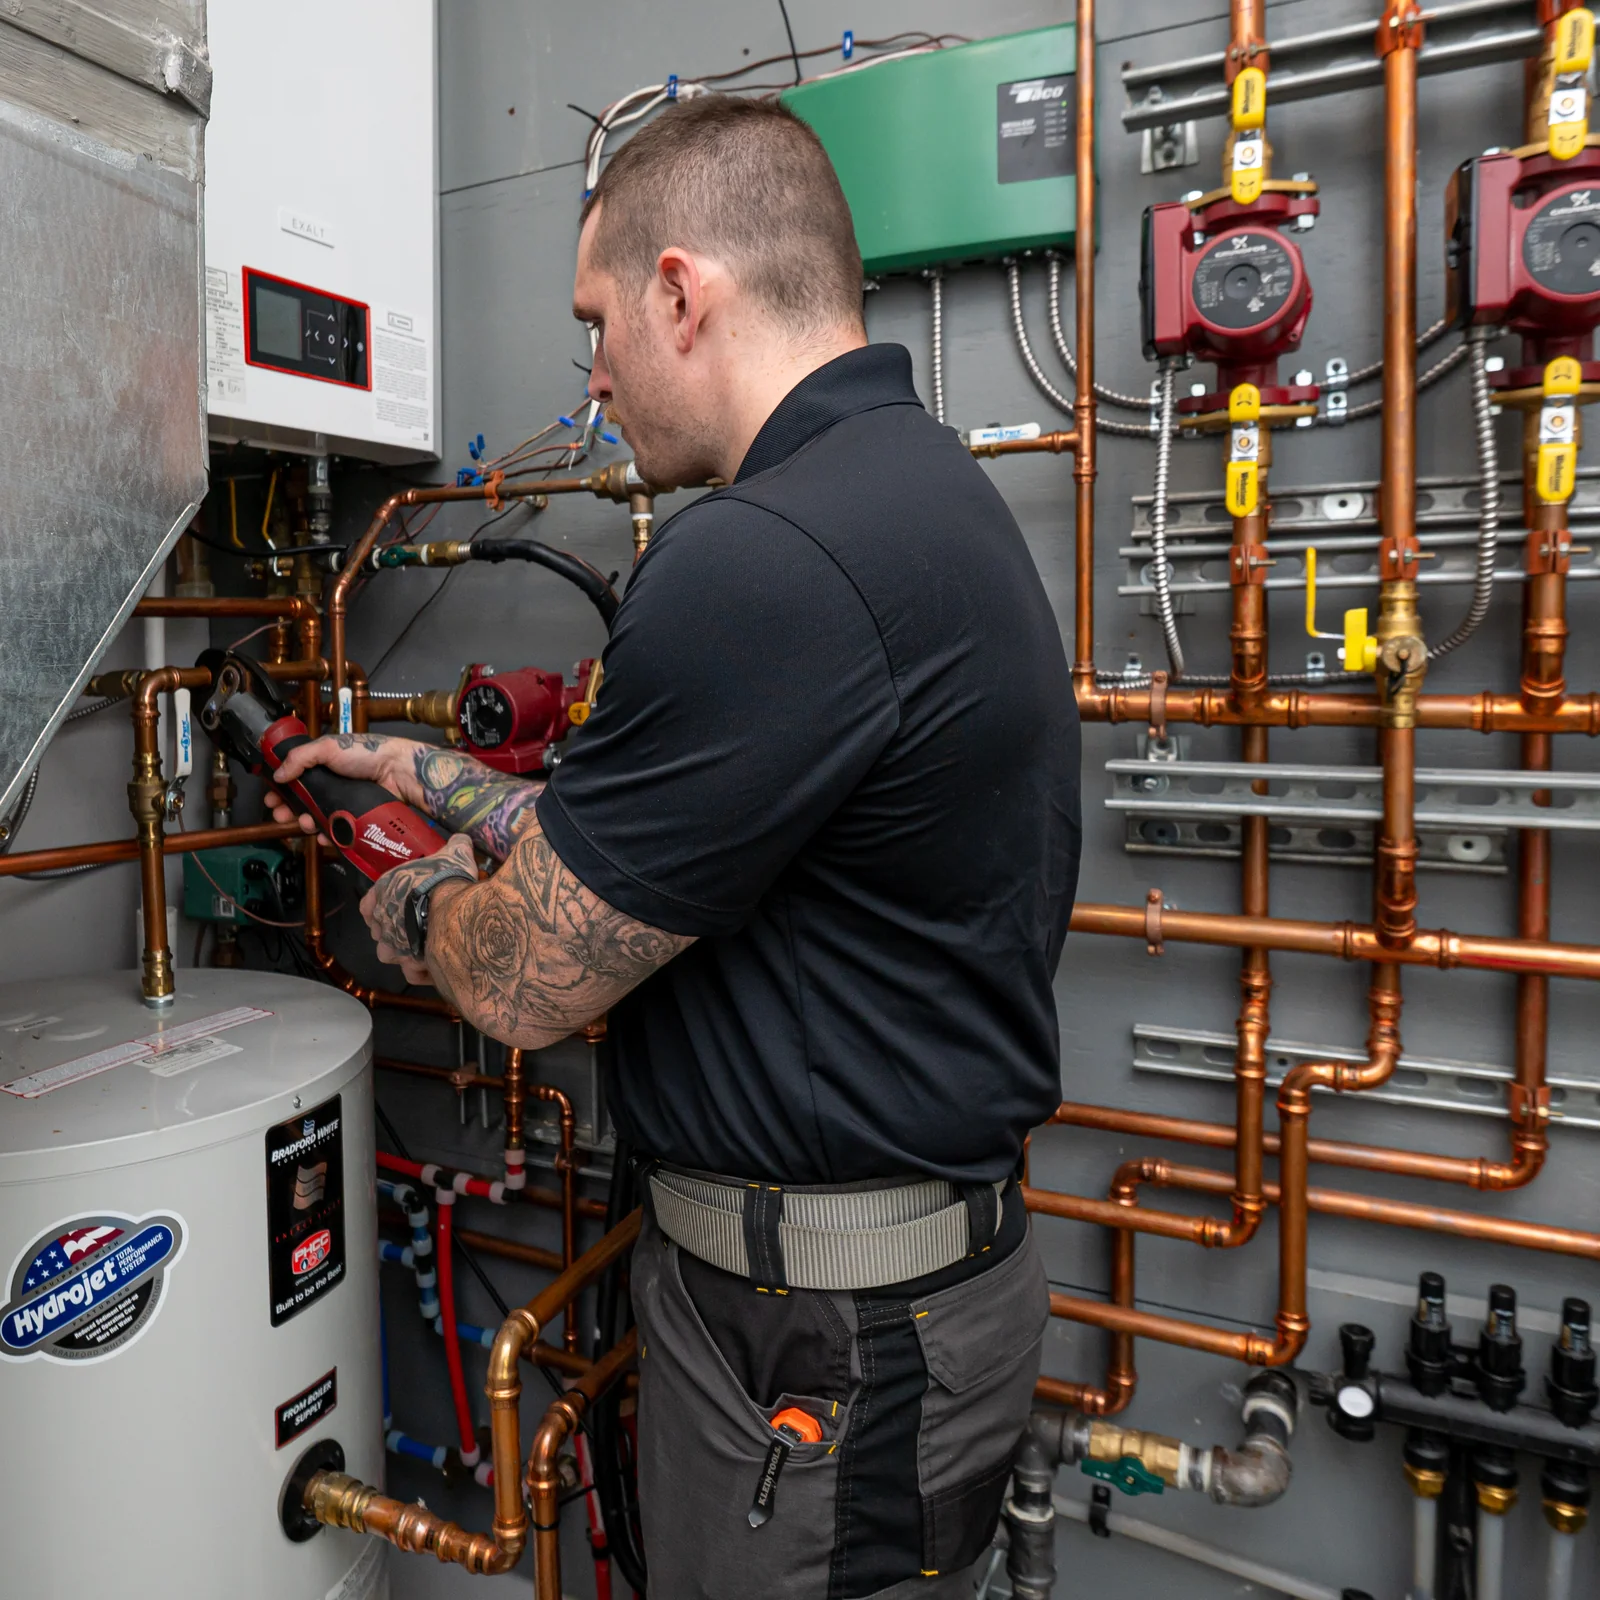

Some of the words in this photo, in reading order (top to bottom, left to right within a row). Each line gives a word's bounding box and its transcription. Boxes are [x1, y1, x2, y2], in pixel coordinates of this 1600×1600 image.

[292, 217, 324, 239] EXALT
[363, 824, 413, 857] Milwaukee
[271, 1133, 316, 1163] BRADFORD
[317, 1118, 340, 1140] WHITE
[115, 1245, 135, 1261] TOTAL
[118, 1232, 164, 1269] PERFORMANCE
[120, 1253, 146, 1276] SYSTEM
[295, 1232, 329, 1263] PHCC
[34, 1261, 88, 1295] EQUIPPED
[94, 1241, 119, 1259] WITH
[13, 1260, 117, 1339] Hydrojet
[72, 1287, 130, 1327] FEATURING
[275, 1297, 294, 1315] Built
[295, 1292, 304, 1303] to
[304, 1286, 315, 1297] be
[315, 1277, 327, 1290] the
[327, 1264, 342, 1281] Best
[52, 1347, 98, 1358] BRADFORD
[102, 1336, 127, 1353] WHITE
[130, 1279, 162, 1335] CORPORATION
[74, 1321, 97, 1339] Reduced
[95, 1306, 119, 1326] Sediment
[85, 1327, 102, 1341] Lower
[101, 1312, 125, 1331] Operating
[123, 1304, 136, 1316] Cost
[96, 1331, 110, 1343] More
[109, 1324, 119, 1334] Hot
[117, 1315, 133, 1328] Water
[283, 1399, 307, 1422] FROM
[307, 1380, 332, 1405] BOILER
[295, 1399, 323, 1426] SUPPLY
[758, 1474, 773, 1506] KLEIN
[768, 1445, 780, 1476] TOOLS
